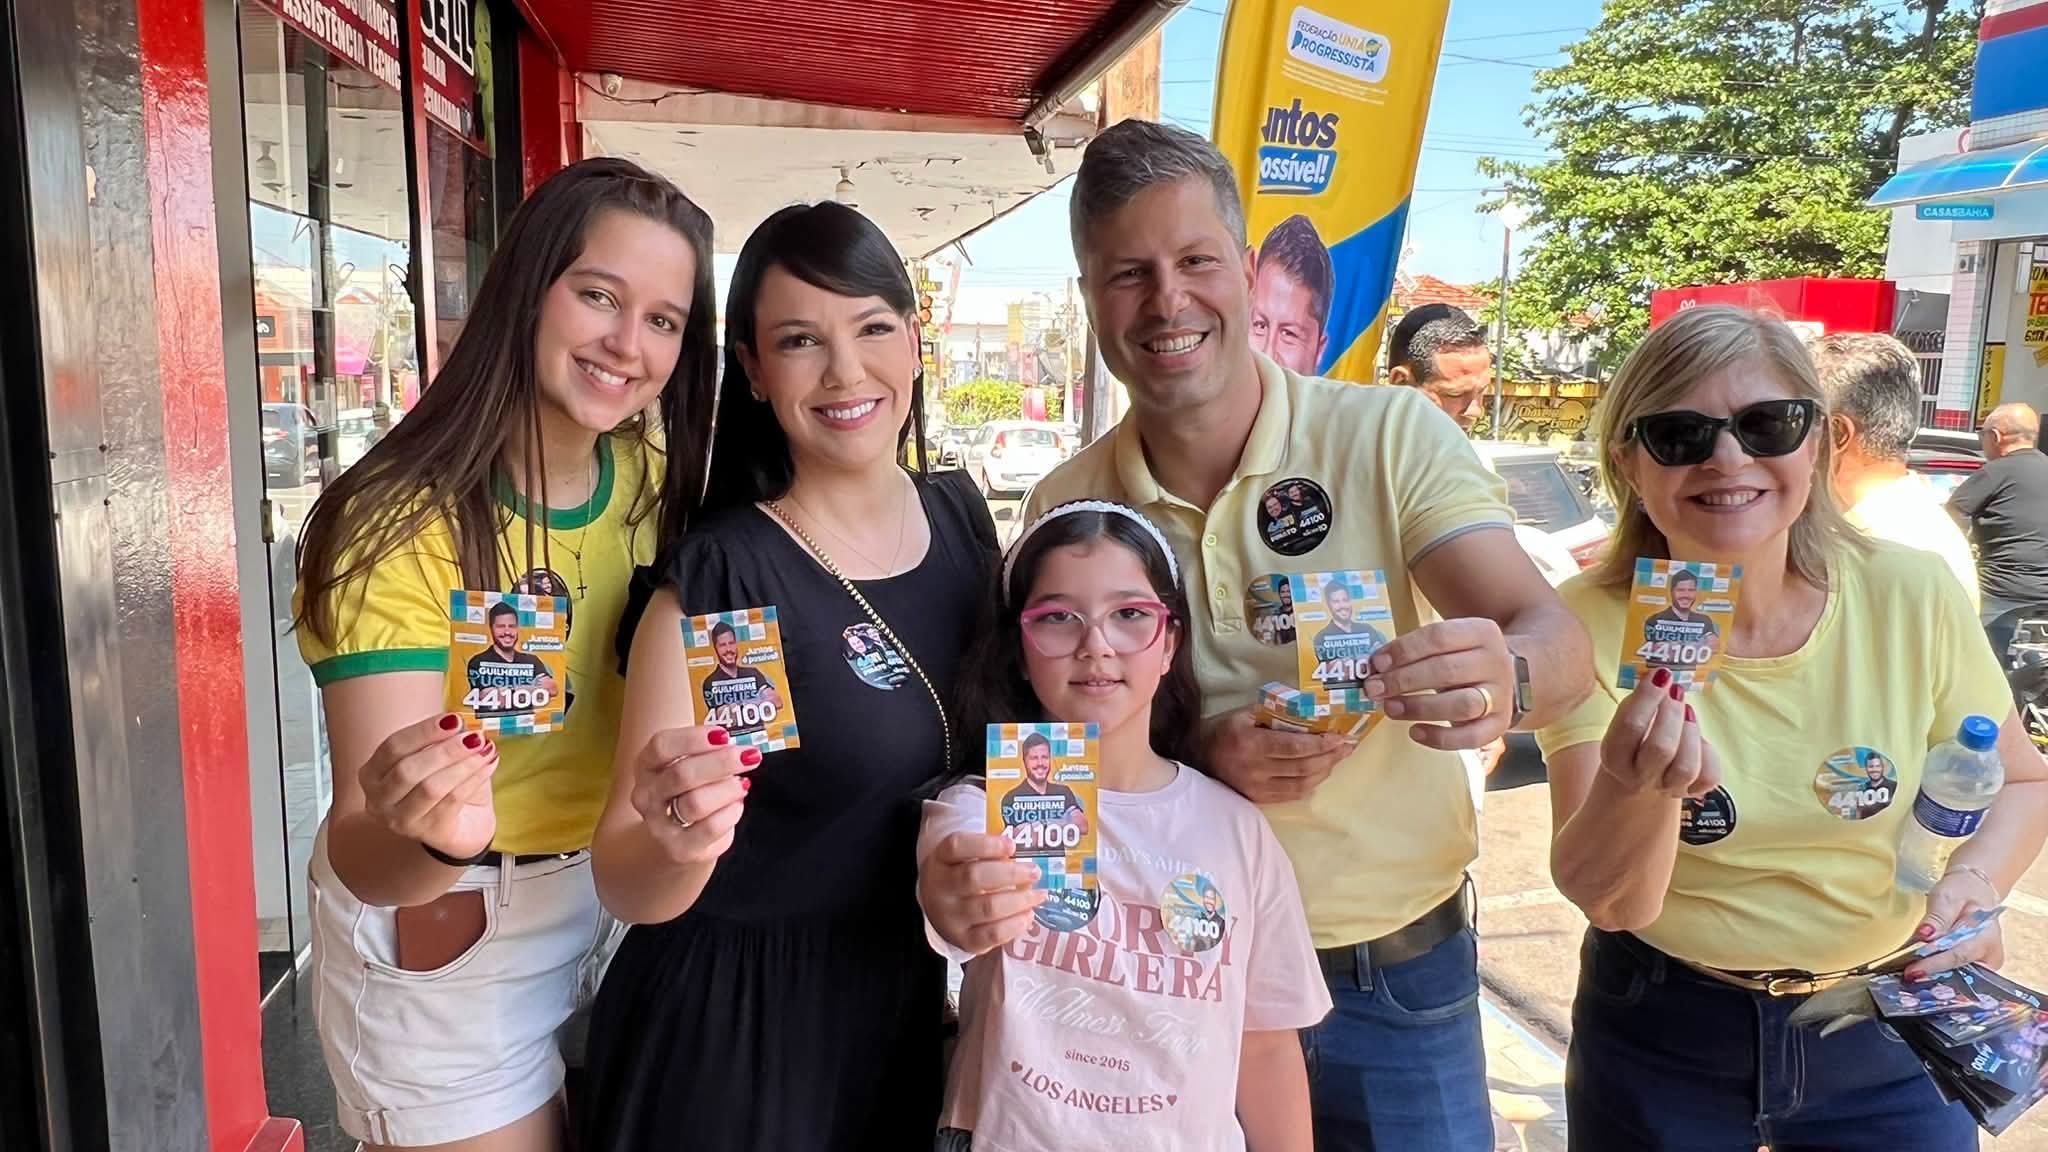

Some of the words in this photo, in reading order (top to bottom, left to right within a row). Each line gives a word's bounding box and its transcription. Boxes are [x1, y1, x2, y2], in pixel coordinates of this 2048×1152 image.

[1291, 30, 1375, 73] PROGRESSISTA
[1636, 641, 1713, 664] 44100
[479, 666, 535, 678] GUILHERME
[1311, 659, 1372, 682] 4410
[462, 687, 550, 710] 44100
[704, 701, 777, 728] 44100
[1012, 801, 1065, 811] GUILHERME
[1828, 787, 1889, 808] 44100
[1168, 914, 1220, 939] 44100
[1003, 921, 1126, 987] GIRL
[1133, 951, 1223, 1003] ERA
[1064, 1048, 1098, 1065] since
[1099, 1055, 1131, 1073] 2015
[1021, 1067, 1064, 1100] LOS
[1064, 1087, 1163, 1114] ANGELES
